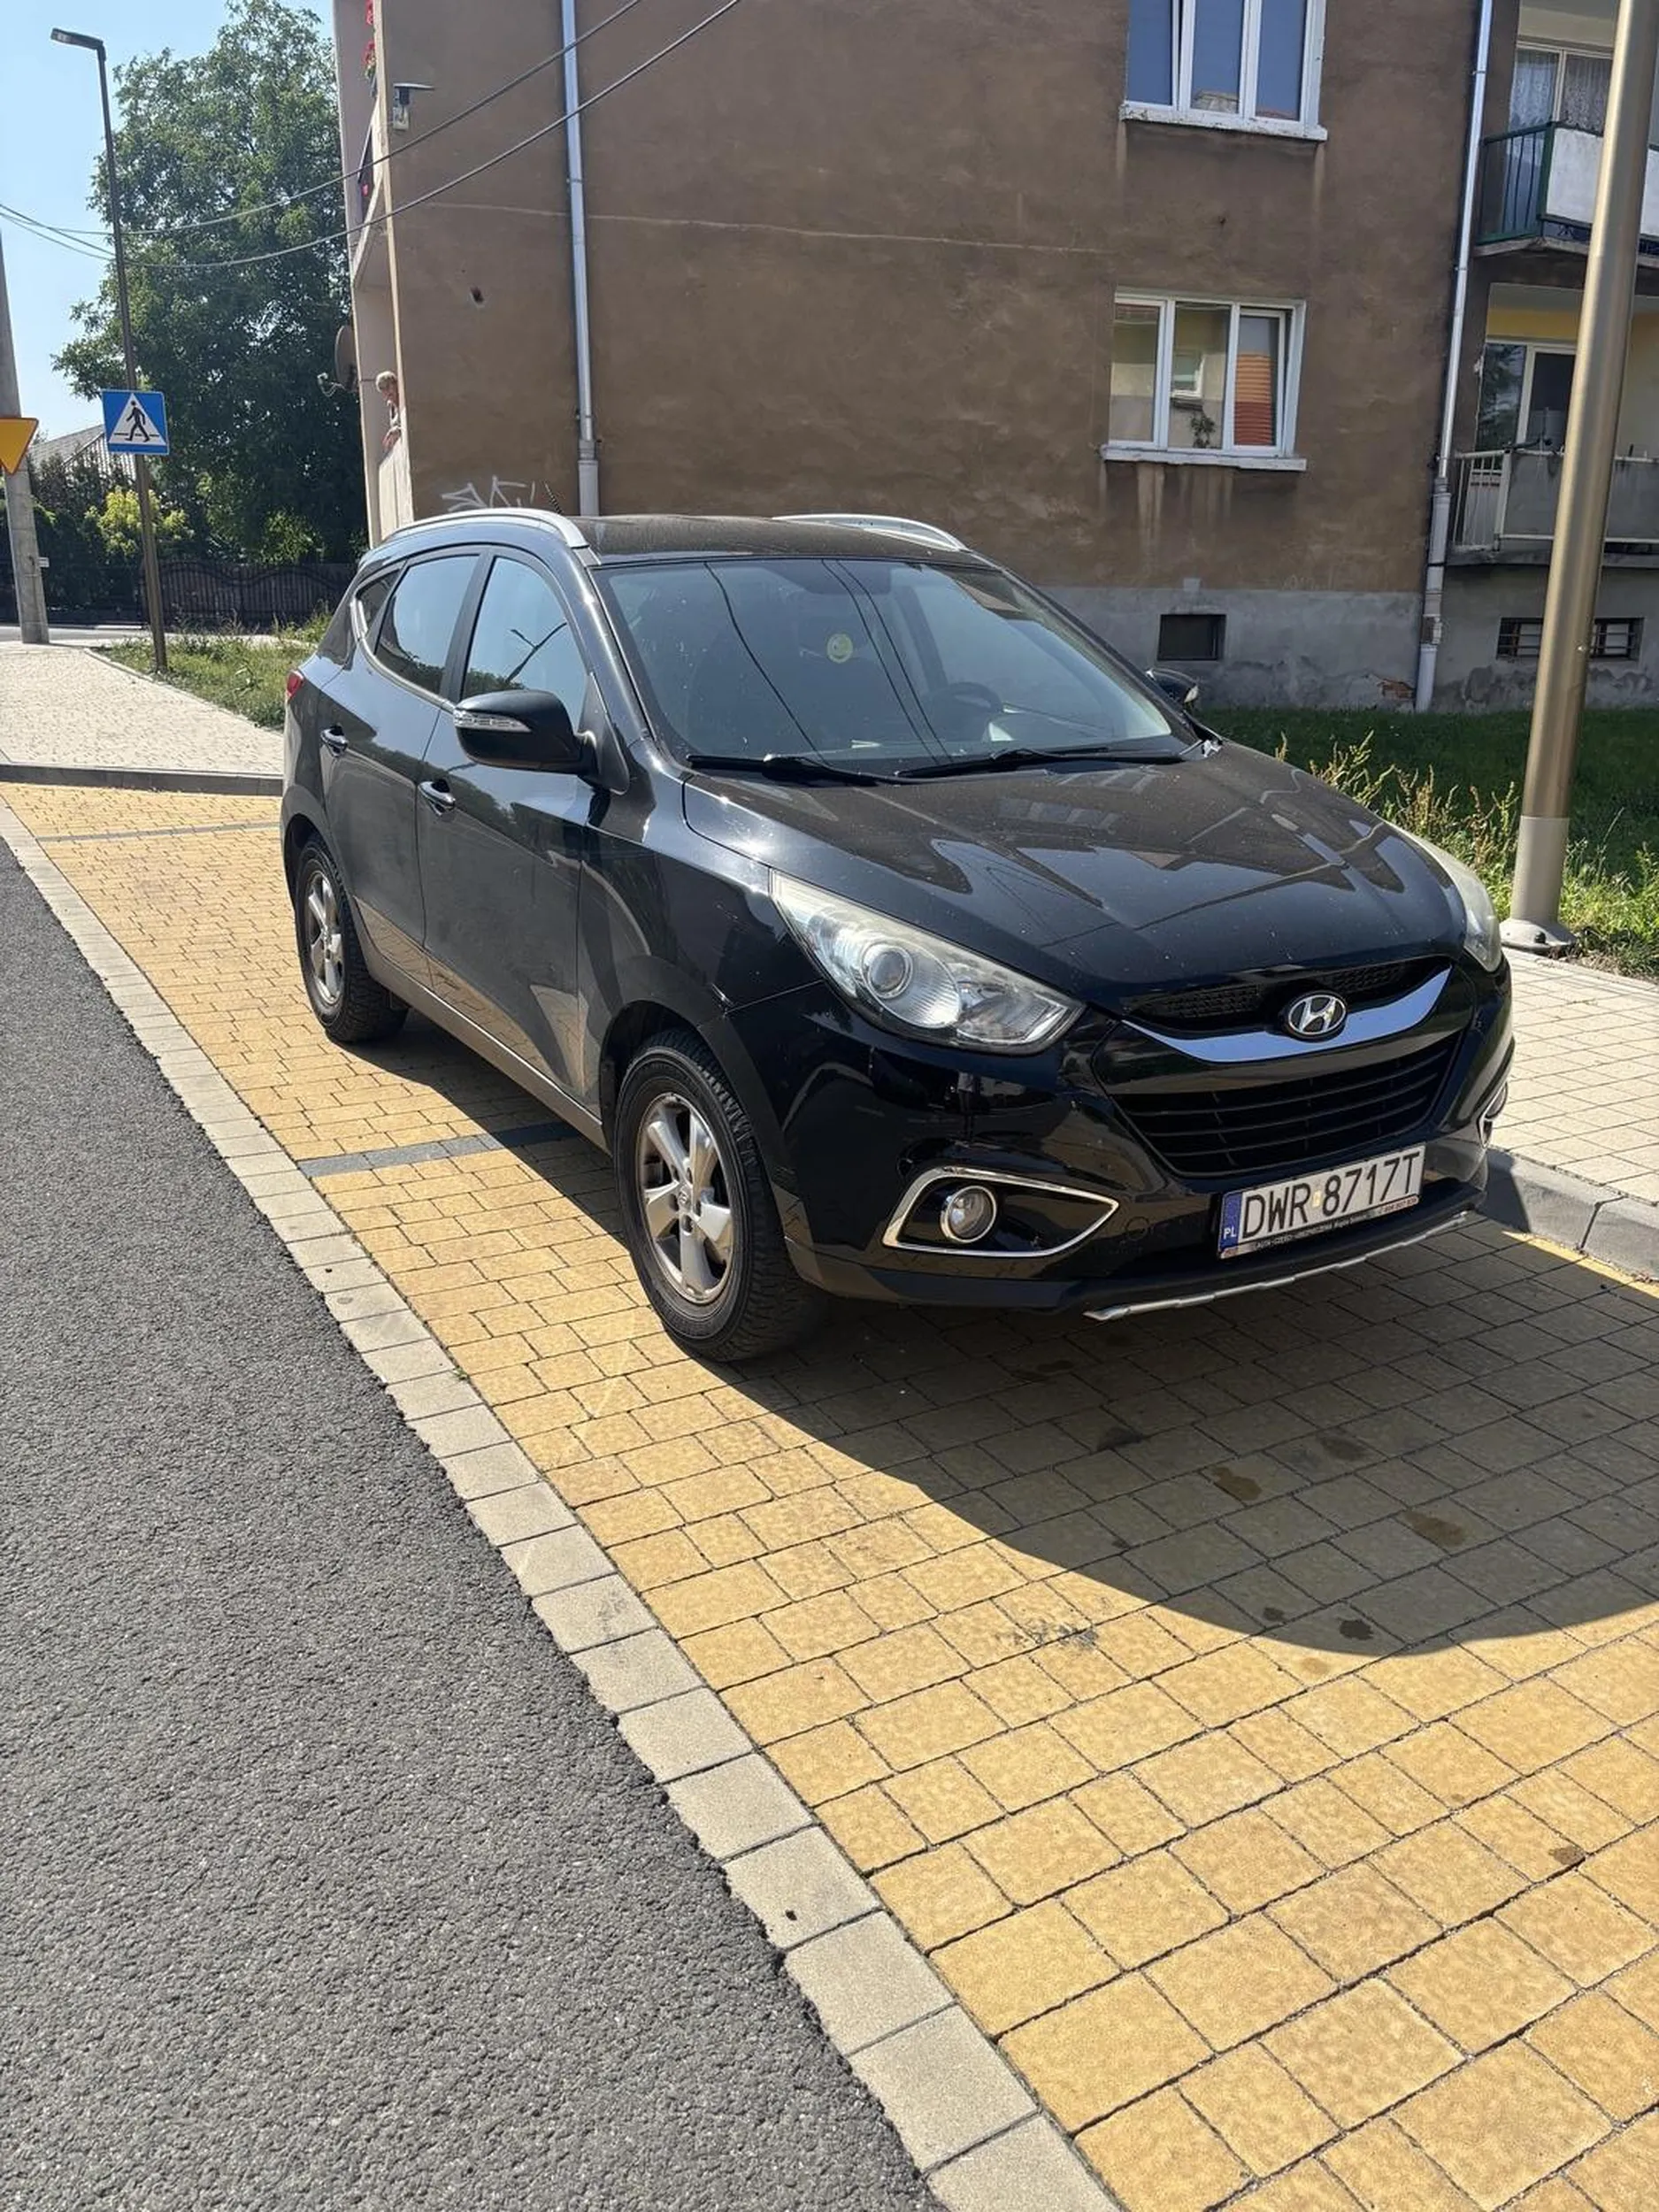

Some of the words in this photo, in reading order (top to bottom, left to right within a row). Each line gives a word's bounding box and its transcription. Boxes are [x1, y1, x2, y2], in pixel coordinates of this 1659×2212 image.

[1242, 1183, 1310, 1239] DWR
[1323, 1151, 1420, 1217] 8717T
[1224, 1225, 1237, 1240] PL
